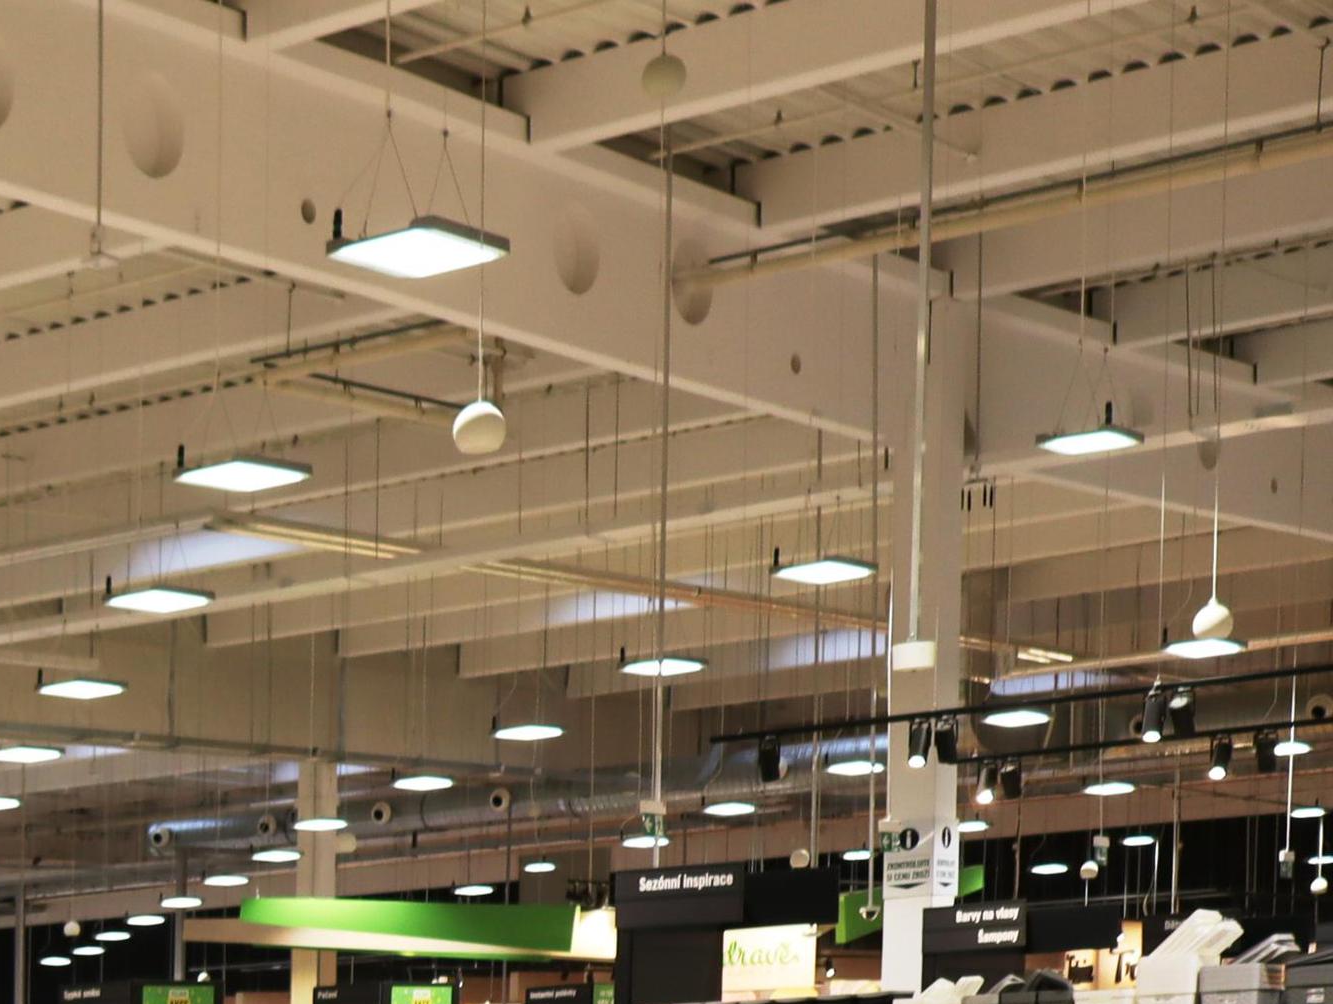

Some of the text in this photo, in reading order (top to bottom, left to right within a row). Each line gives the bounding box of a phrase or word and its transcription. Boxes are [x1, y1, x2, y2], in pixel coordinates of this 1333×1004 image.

[639, 872, 733, 892] Sezónní inspirace
[983, 911, 994, 920] na
[995, 907, 1020, 921] vlasy
